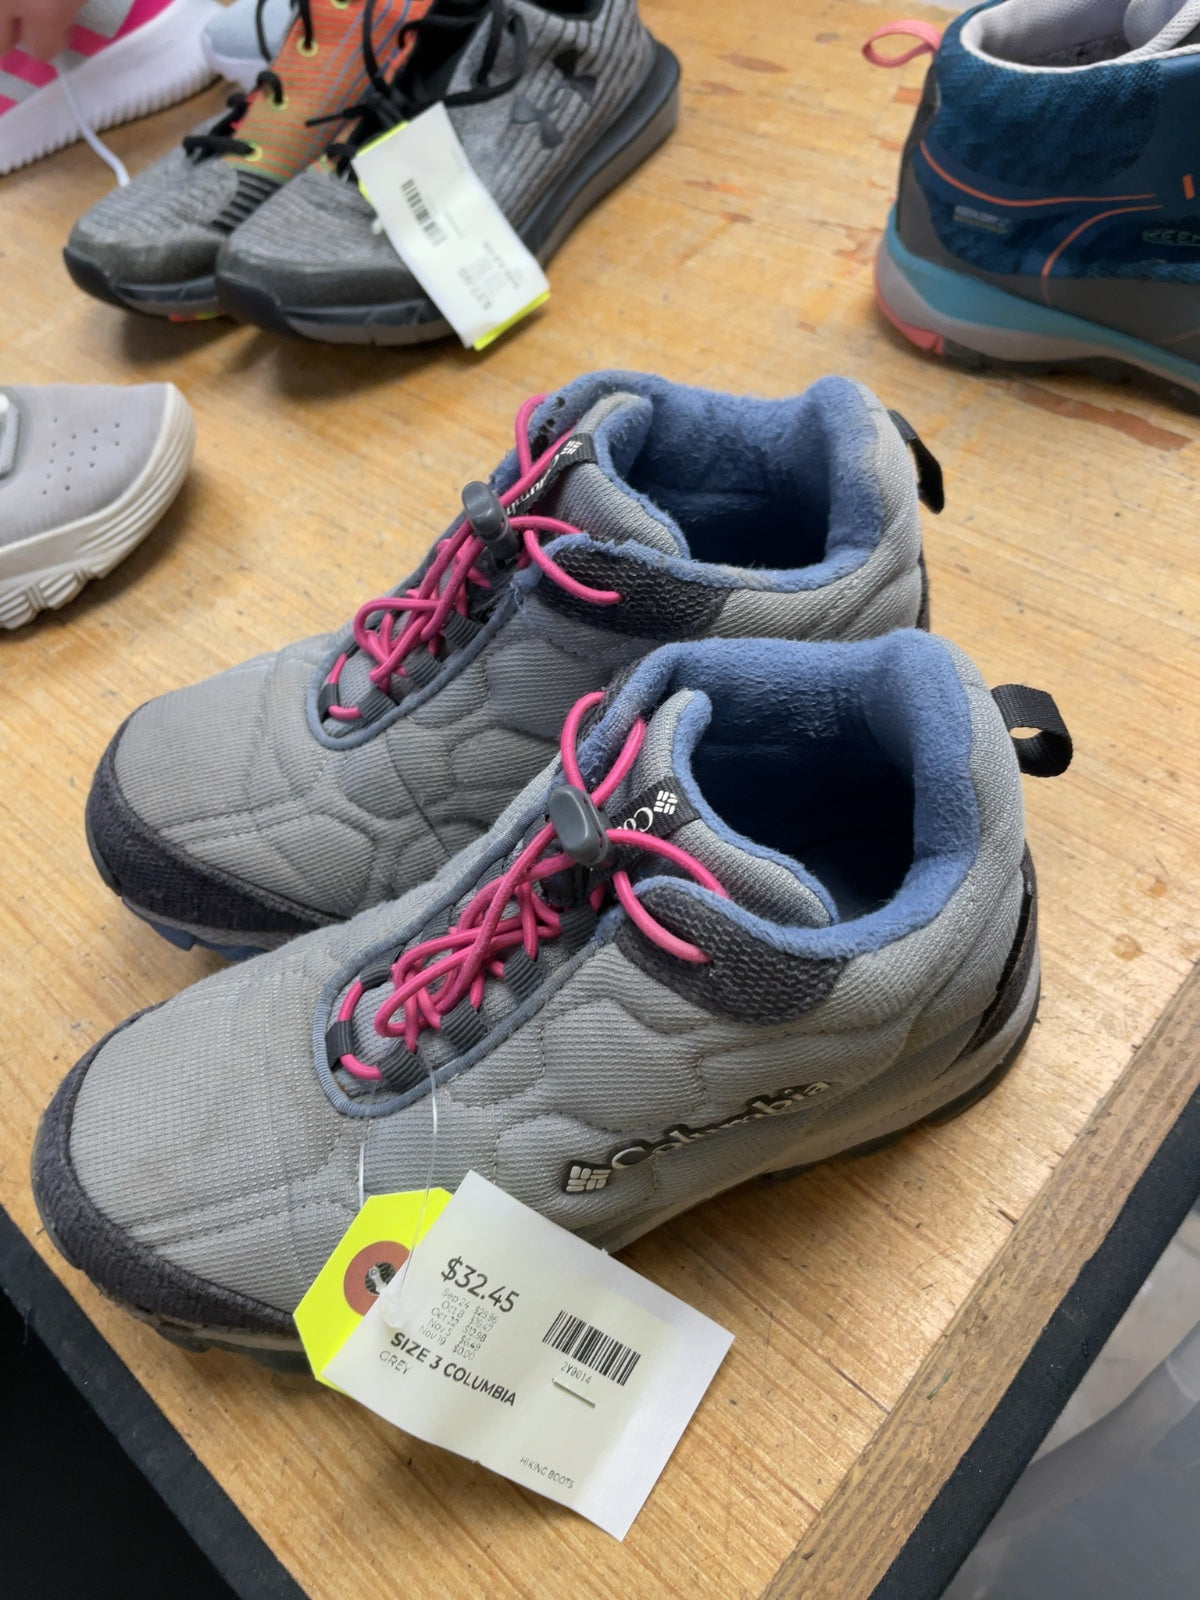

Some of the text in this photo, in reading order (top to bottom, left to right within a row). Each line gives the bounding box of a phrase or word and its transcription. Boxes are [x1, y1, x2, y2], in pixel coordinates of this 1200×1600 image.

[441, 1256, 520, 1313] $32.45
[379, 1350, 411, 1375] GREY
[390, 1332, 516, 1406] SIZE 3 COLUMBIA
[520, 1456, 575, 1489] HIKING BOOTS
